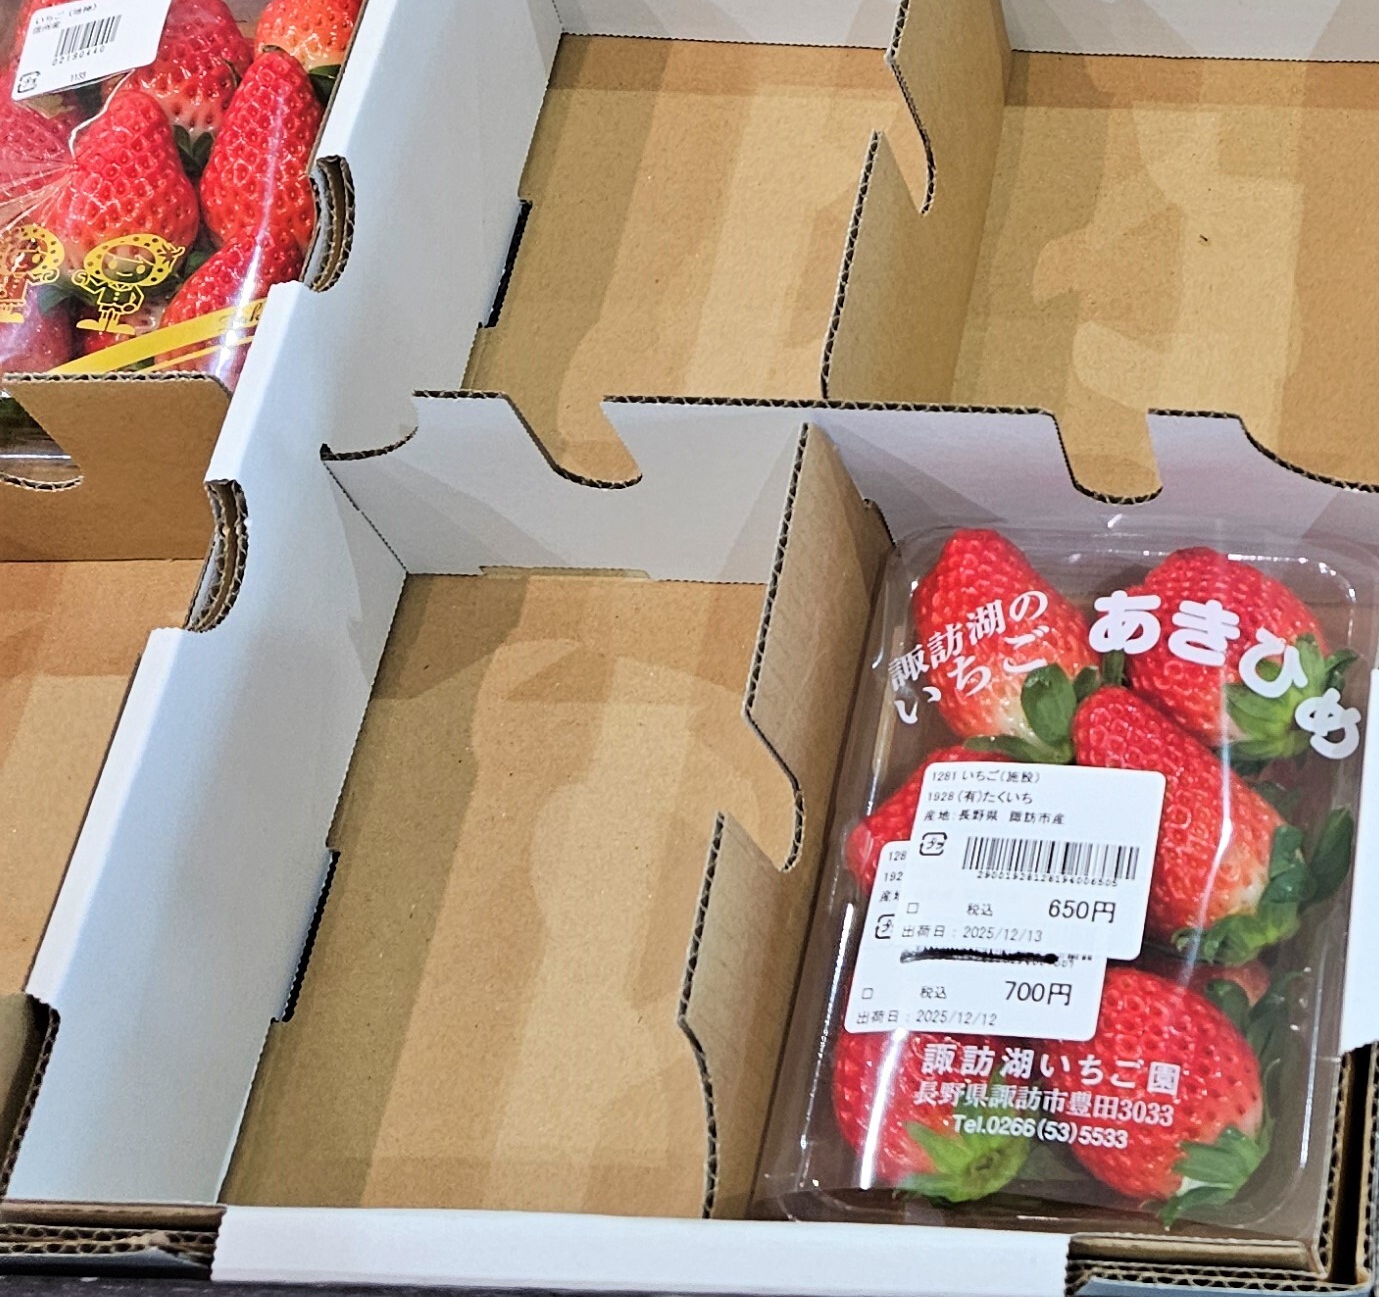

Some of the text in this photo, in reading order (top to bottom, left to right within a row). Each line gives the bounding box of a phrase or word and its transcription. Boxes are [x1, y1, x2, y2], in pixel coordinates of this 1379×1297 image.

[887, 589, 1049, 691] 諏訪湖の
[1088, 590, 1362, 759] あきひめ
[932, 770, 1040, 783] 1281 いちご(施設)
[928, 791, 1032, 804] 1928 (有)たくいち
[1009, 813, 1064, 825] 諏訪市産
[967, 900, 1116, 923] 税込 650円
[963, 926, 1042, 942] 2025/12/13
[920, 981, 1072, 1006] 税込 700円
[916, 1010, 997, 1026] 2025/12/12
[921, 1042, 1181, 1095] 諏訪湖いちご園
[914, 1080, 1174, 1127] 長野県諏訪市豊田3033
